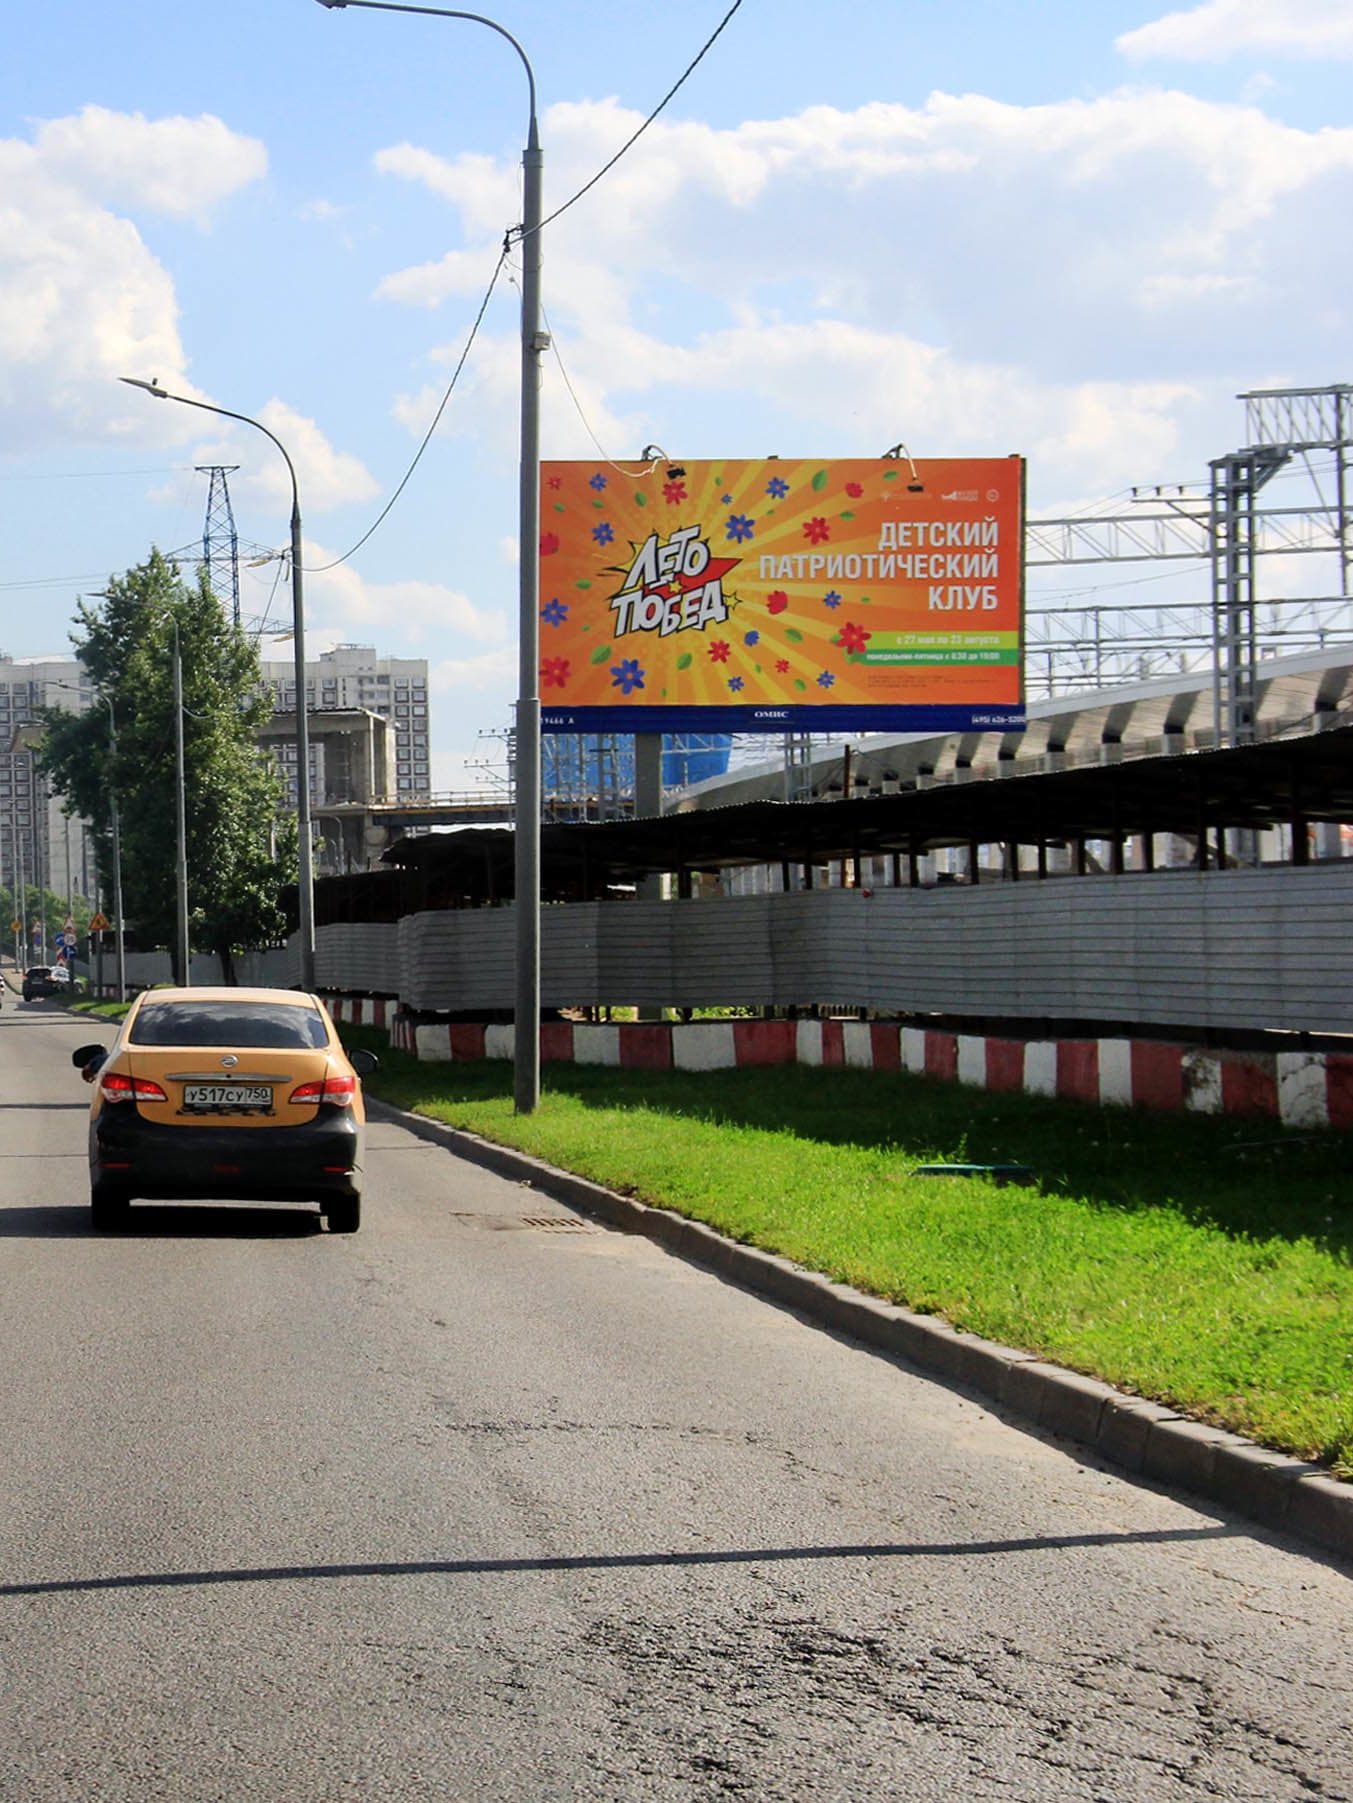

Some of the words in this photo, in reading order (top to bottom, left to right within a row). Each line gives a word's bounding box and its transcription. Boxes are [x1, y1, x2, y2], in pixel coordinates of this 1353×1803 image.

[878, 515, 999, 552] ДЕТСКИЙ
[622, 524, 710, 591] ЛЕТО
[759, 547, 999, 580] ПАТРИОТИЧЕСКИЙ
[609, 577, 729, 639] ПОБЕД
[927, 584, 999, 611] КЛУБ
[247, 1087, 269, 1099] 750
